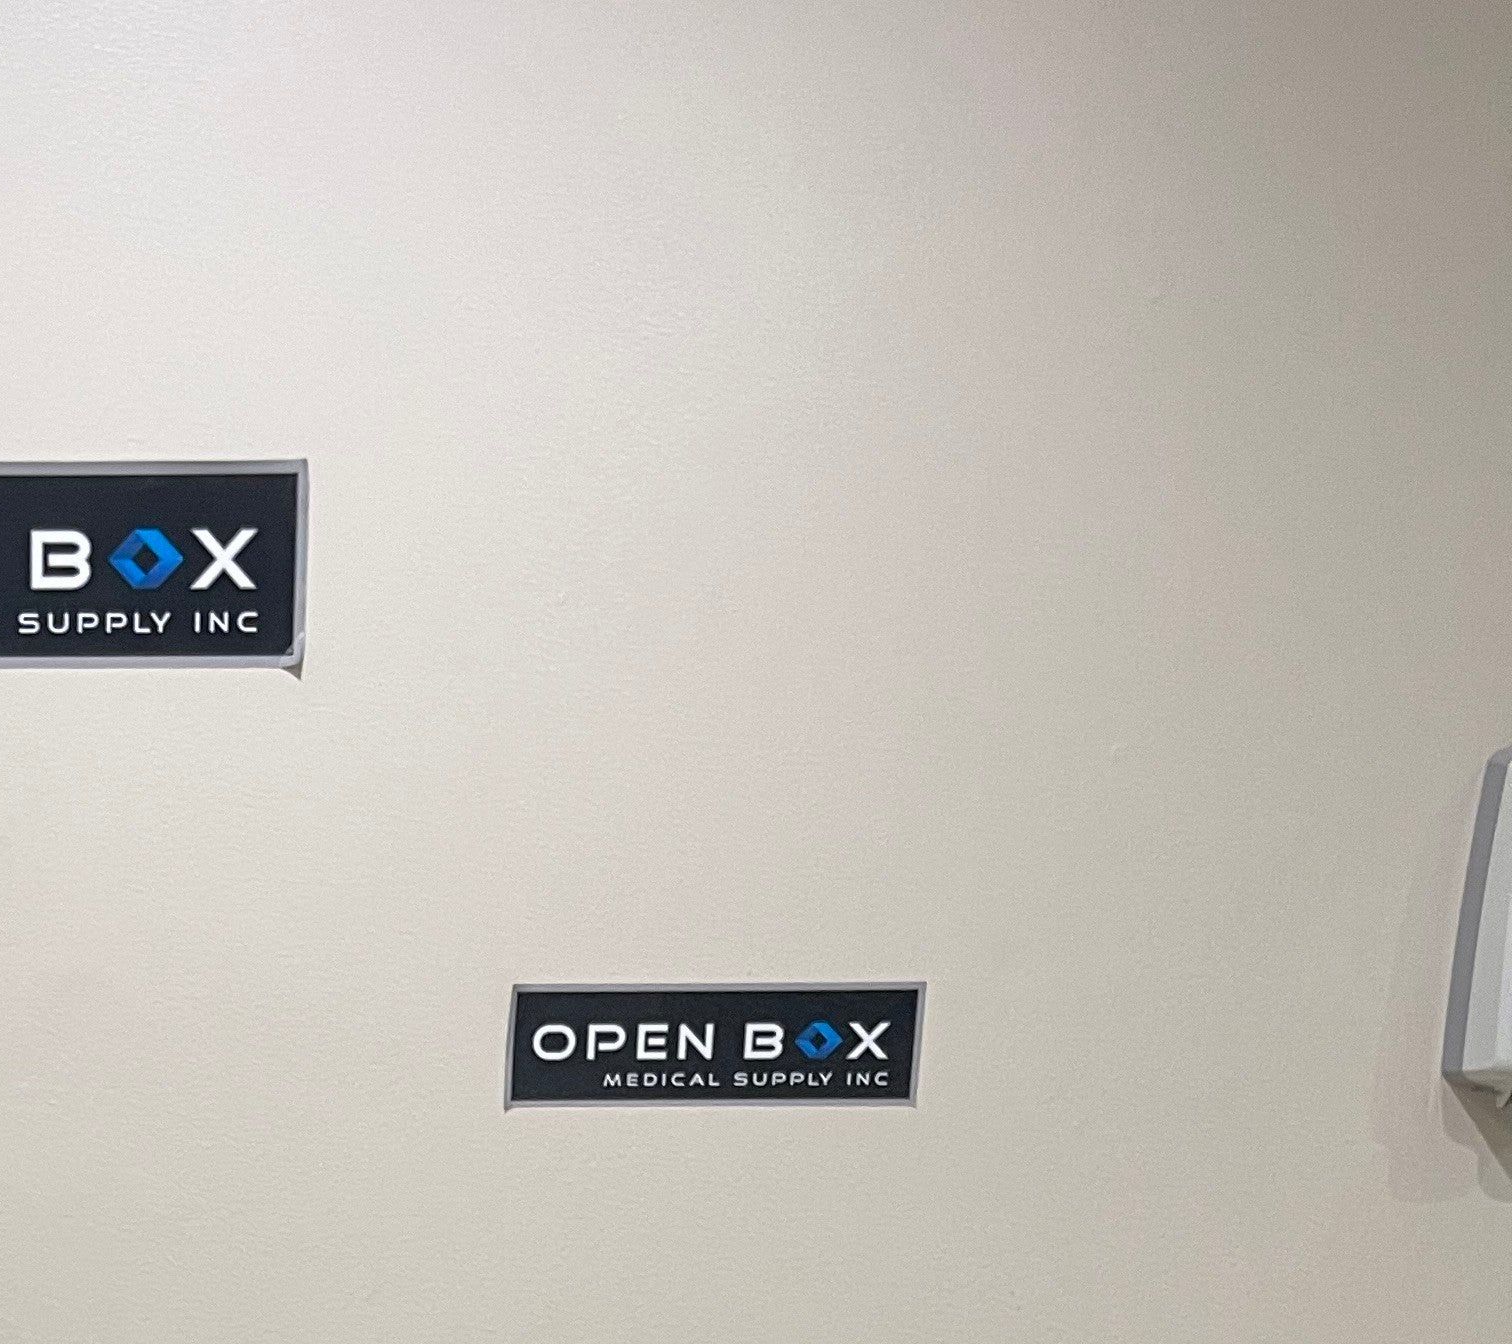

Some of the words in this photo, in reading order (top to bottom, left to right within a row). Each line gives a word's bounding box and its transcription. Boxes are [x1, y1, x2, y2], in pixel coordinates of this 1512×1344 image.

[18, 611, 171, 634] SUPPLY
[194, 611, 259, 633] INC
[532, 1023, 715, 1061] OPEN
[603, 1072, 720, 1087] MEDICAL
[733, 1071, 833, 1087] SUPPLY
[846, 1071, 889, 1086] INC
